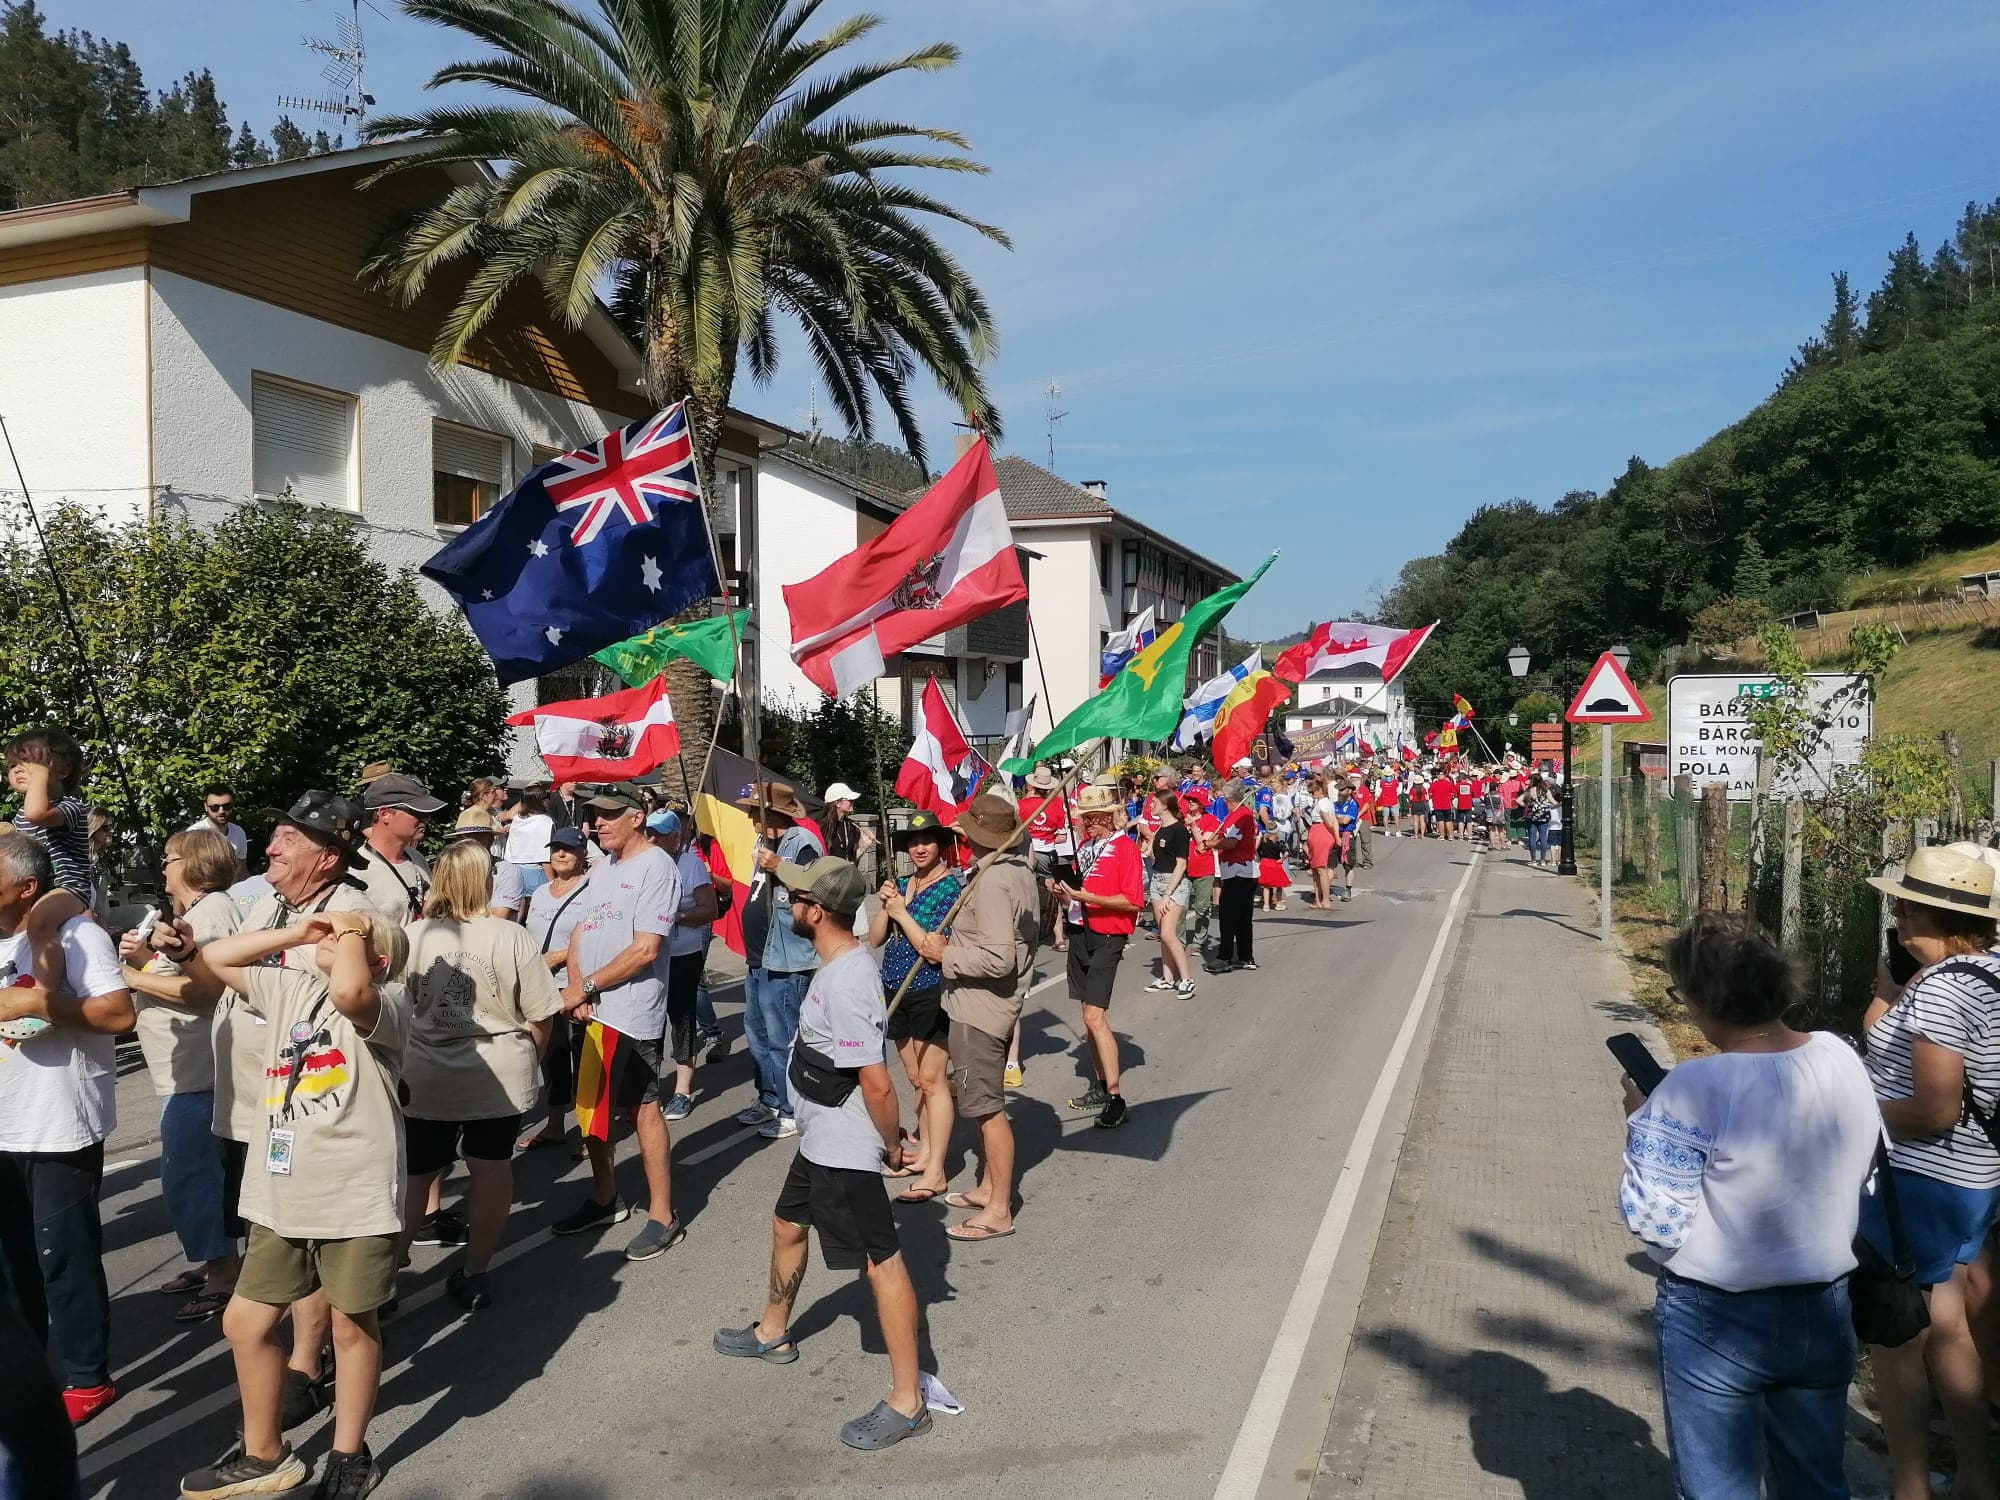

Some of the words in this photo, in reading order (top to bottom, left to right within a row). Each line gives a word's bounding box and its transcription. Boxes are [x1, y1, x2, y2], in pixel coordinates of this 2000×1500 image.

[1839, 716, 1860, 729] 10
[1679, 746, 1707, 756] DEL
[1679, 762, 1730, 776] POLA
